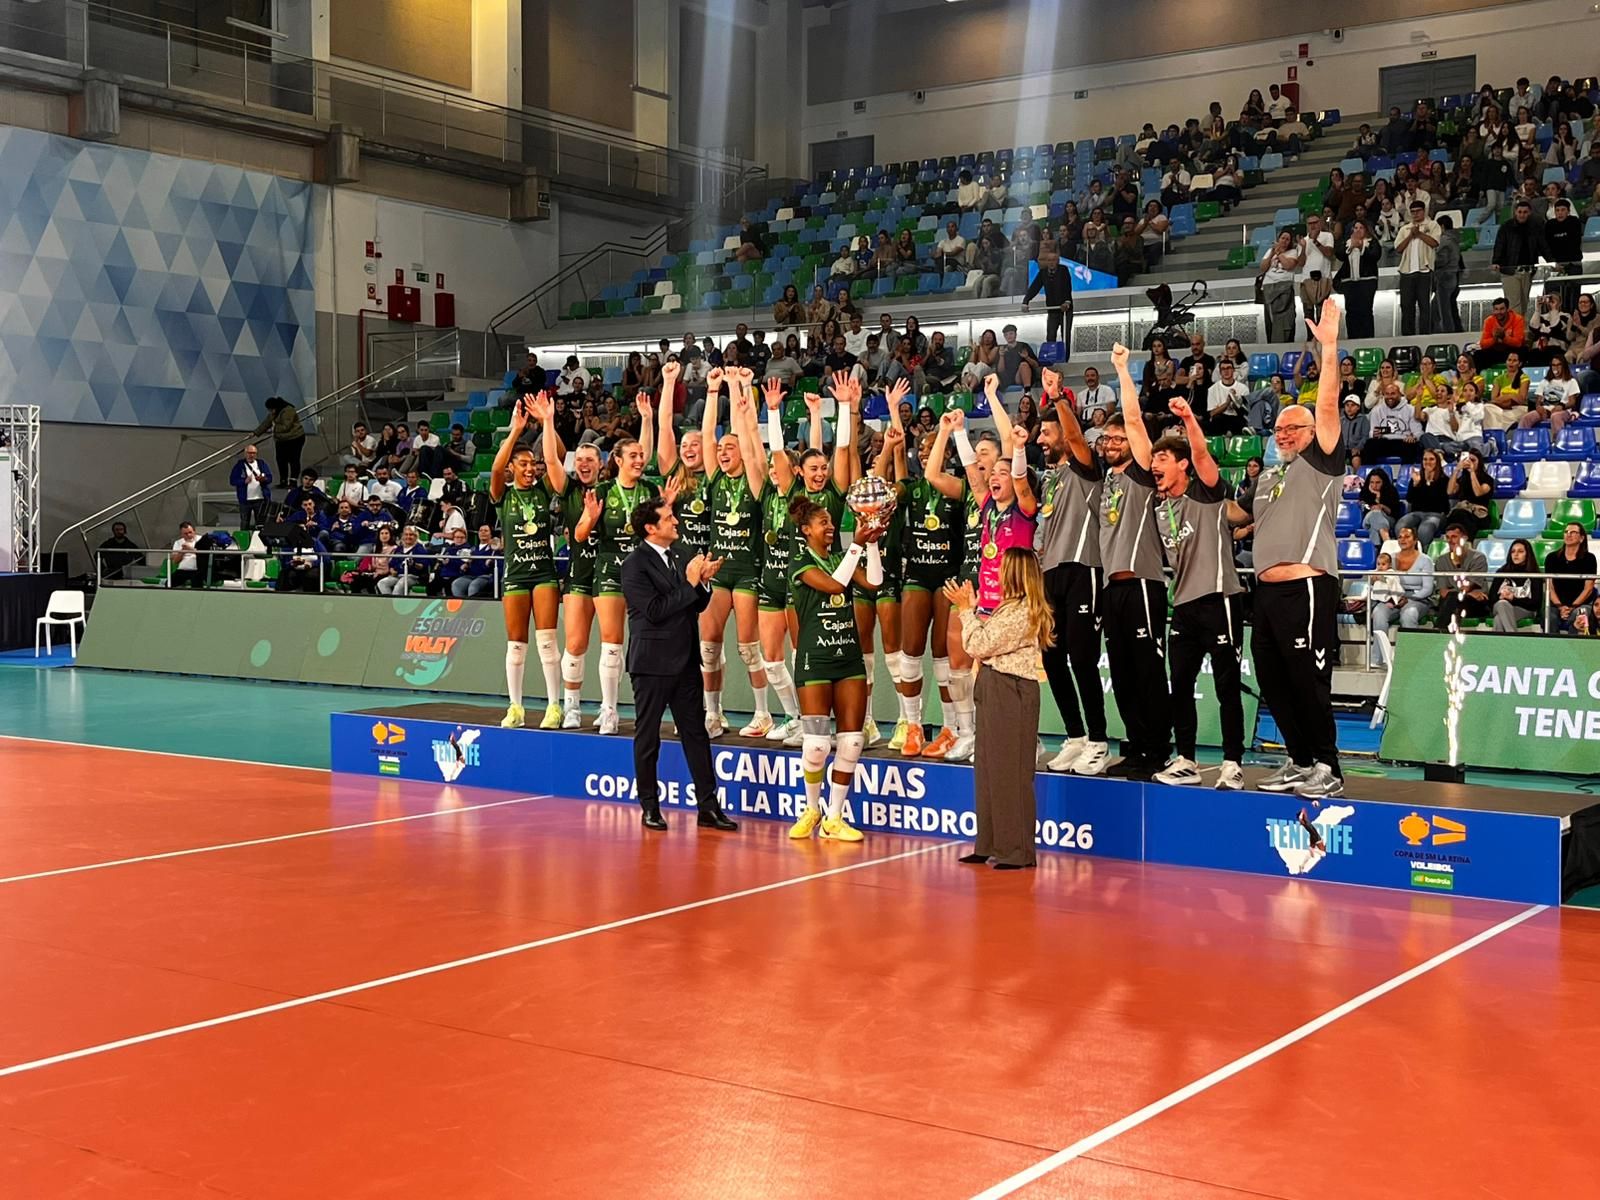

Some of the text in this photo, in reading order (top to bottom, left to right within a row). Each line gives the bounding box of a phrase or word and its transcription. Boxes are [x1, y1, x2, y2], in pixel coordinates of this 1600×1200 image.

[716, 510, 751, 519] Funión
[685, 521, 711, 533] Cajas
[718, 526, 750, 539] Cajasol
[769, 545, 789, 559] Cajas
[916, 538, 950, 552] Cajasol
[822, 619, 854, 633] Cajasol
[404, 634, 458, 654] VOLEY
[1460, 664, 1578, 698] SANTA
[1515, 706, 1600, 740] TENE
[432, 739, 480, 766] TENIFE
[715, 751, 925, 800] CAMPNAS
[741, 788, 772, 814] LA
[778, 792, 856, 823] RENA
[863, 801, 977, 837] IBERDRO
[1266, 817, 1353, 855] TENEIFE
[1394, 849, 1414, 858] COPA
[1410, 861, 1454, 873] VOLEIBOL
